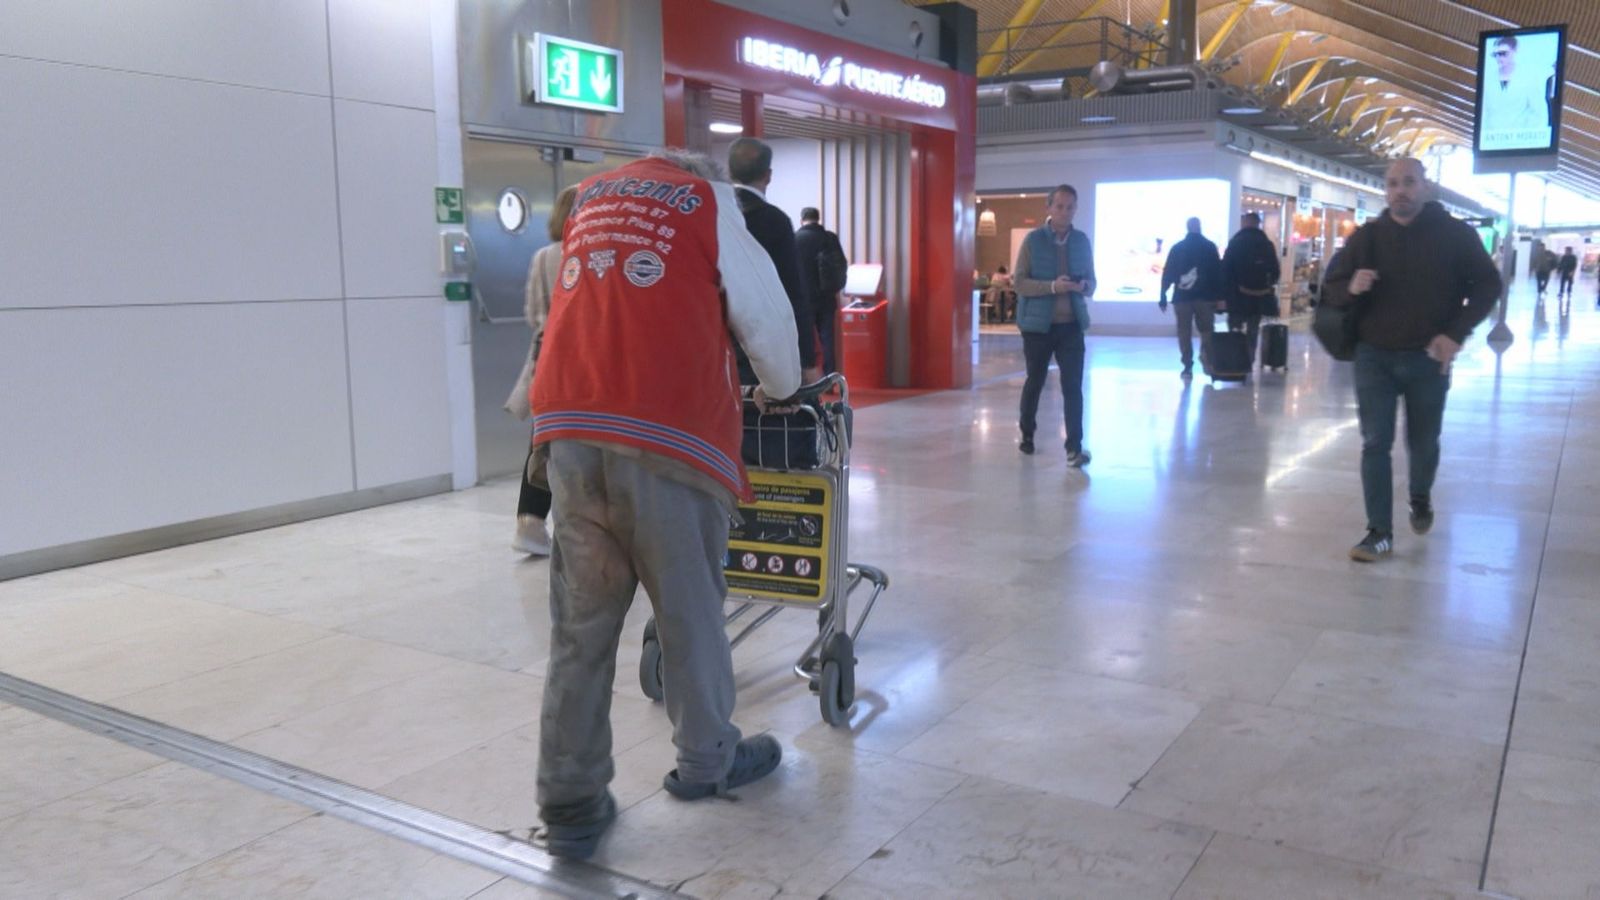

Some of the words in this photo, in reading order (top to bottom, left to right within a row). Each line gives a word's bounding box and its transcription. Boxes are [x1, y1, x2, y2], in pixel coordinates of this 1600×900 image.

[743, 36, 821, 79] IBERIA
[843, 62, 903, 97] PUENTE
[901, 74, 946, 108] AÉREO
[620, 202, 648, 214] Plus
[650, 207, 669, 219] 87
[626, 216, 655, 231] Plus
[657, 225, 676, 239] 89
[581, 230, 652, 246] Performance
[655, 240, 673, 255] 92
